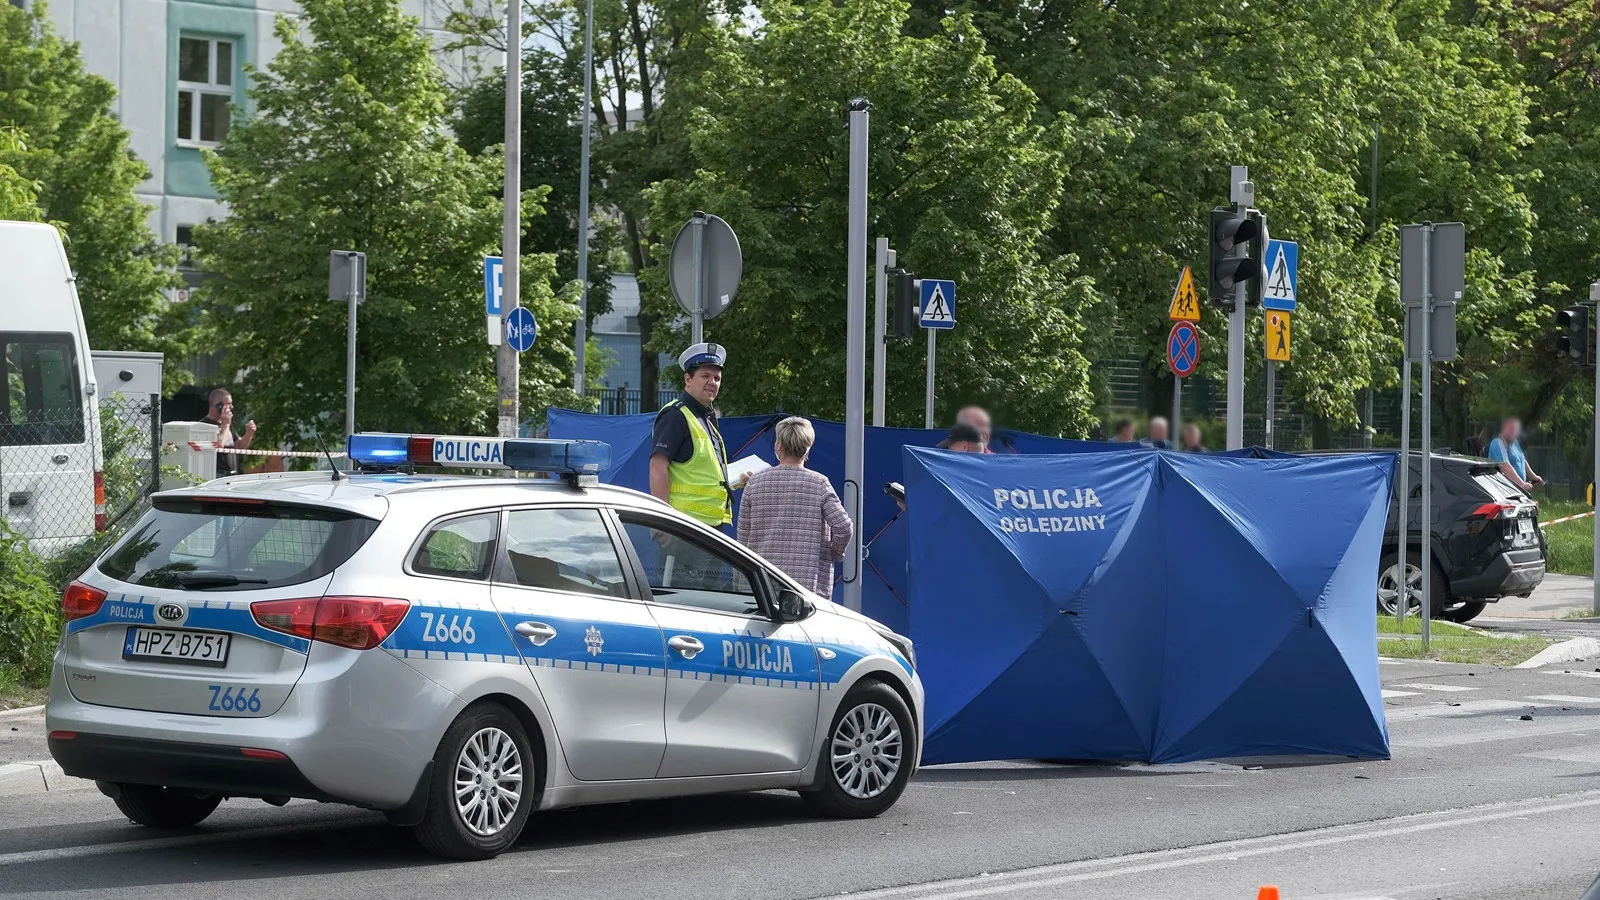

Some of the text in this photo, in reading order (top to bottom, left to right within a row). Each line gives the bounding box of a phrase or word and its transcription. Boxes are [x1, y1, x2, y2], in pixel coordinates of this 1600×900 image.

[434, 441, 502, 462] POLICJA
[993, 488, 1103, 510] POLICJA
[1000, 514, 1106, 536] OGLĘDZINY
[110, 605, 144, 620] POLICJA
[160, 607, 180, 619] KIA
[420, 612, 476, 644] Z666
[135, 631, 223, 659] HPZ B751
[722, 640, 794, 673] POLICJA
[208, 685, 261, 713] Z666
